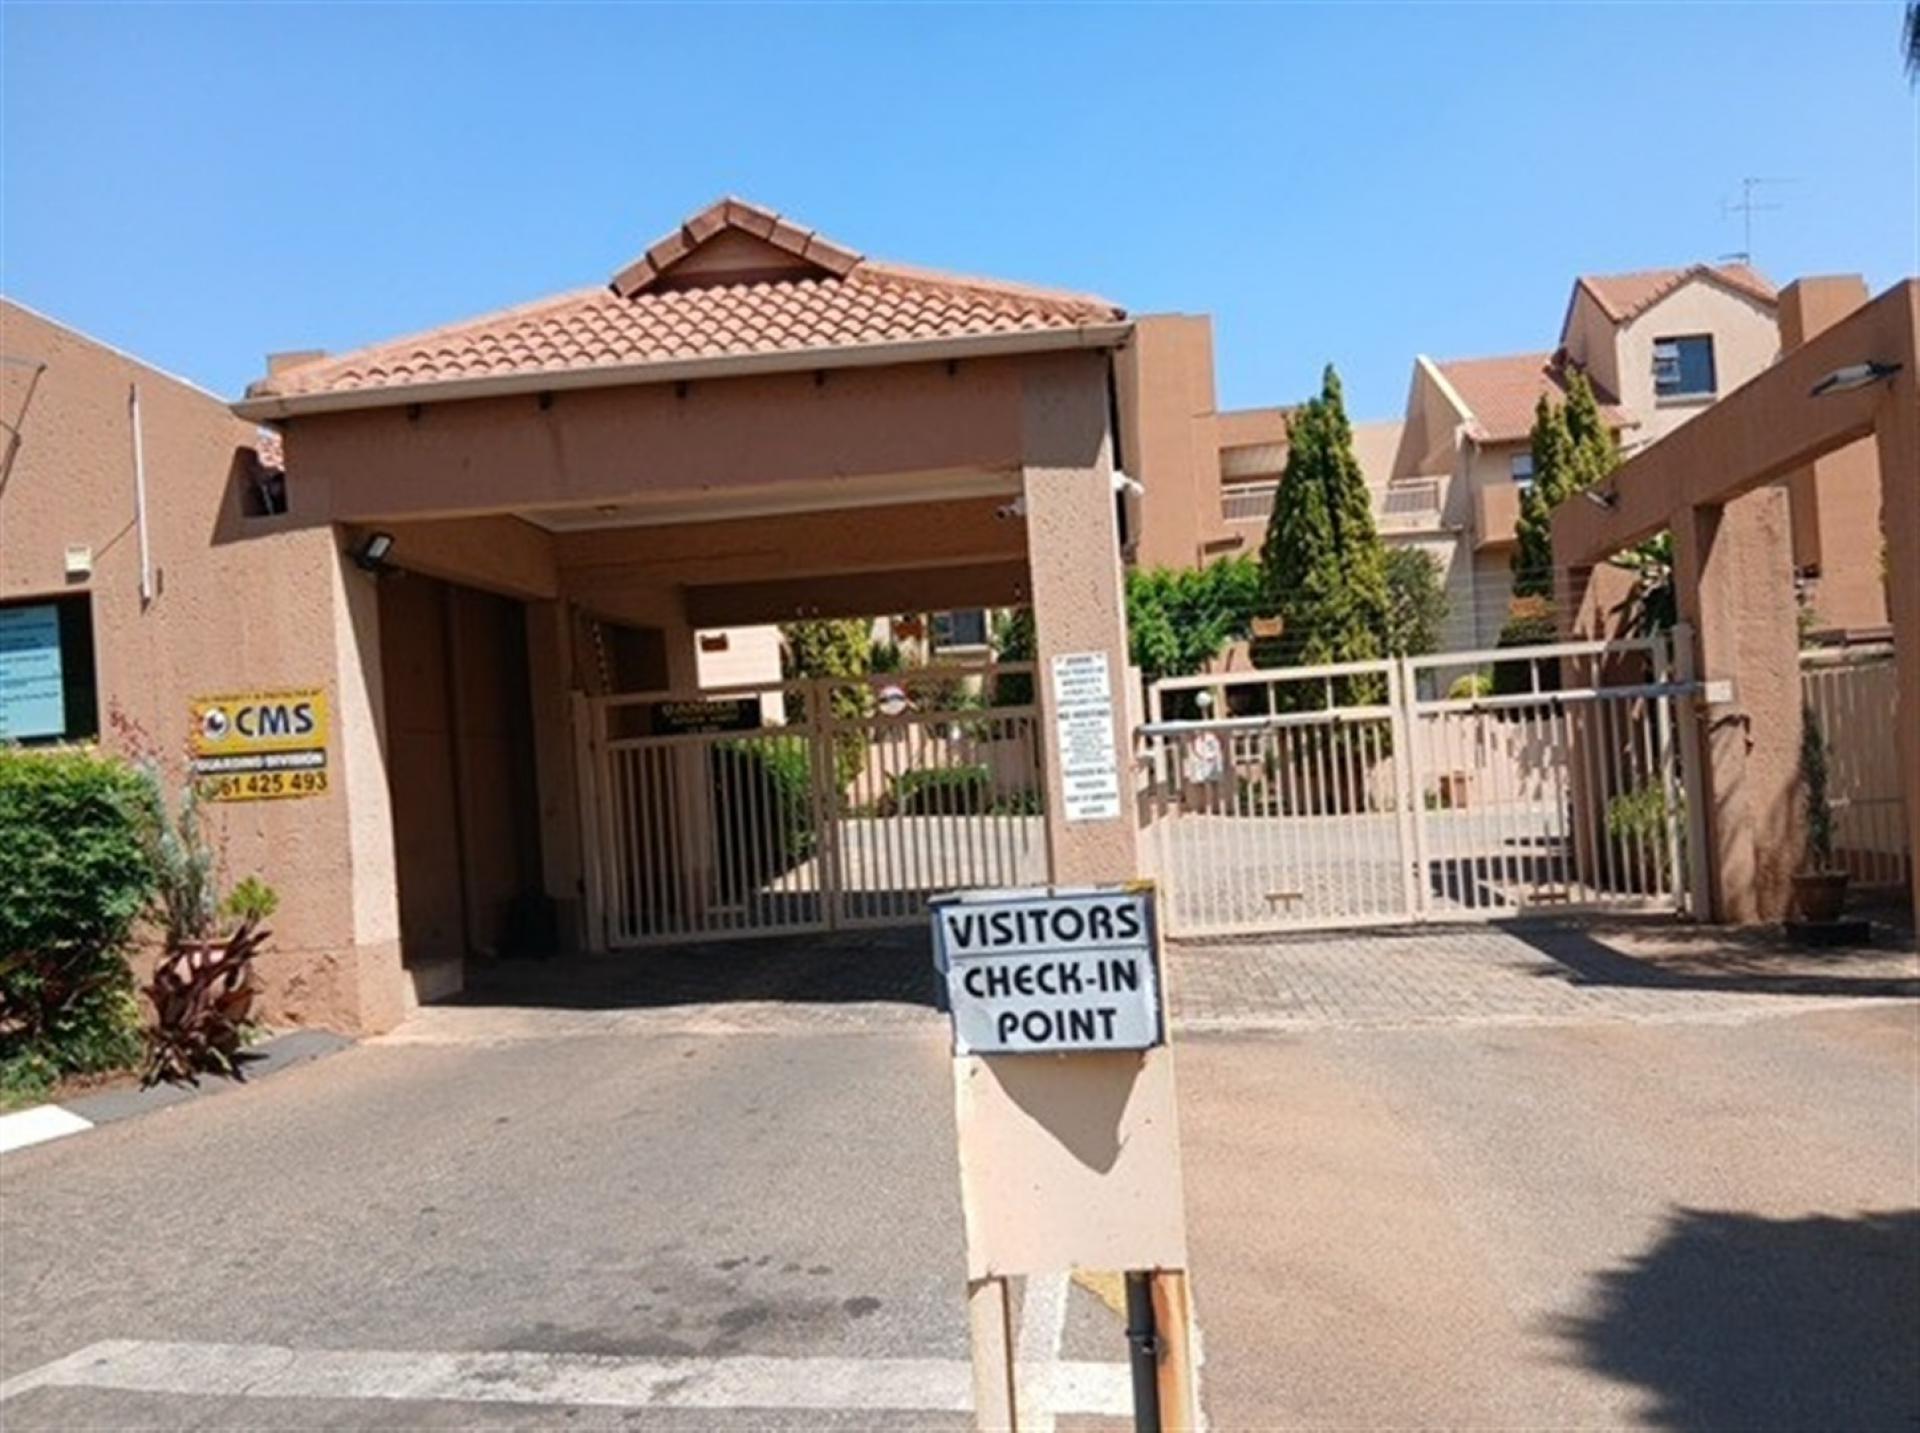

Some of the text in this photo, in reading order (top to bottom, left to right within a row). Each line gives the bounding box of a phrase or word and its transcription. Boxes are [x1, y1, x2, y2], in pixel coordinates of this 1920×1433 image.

[235, 702, 313, 737] CMS
[247, 772, 284, 793] 425
[290, 770, 327, 791] 493
[948, 904, 1140, 948] VISITORS
[964, 959, 1138, 998] CHECK-IN
[998, 1008, 1116, 1043] POINT
